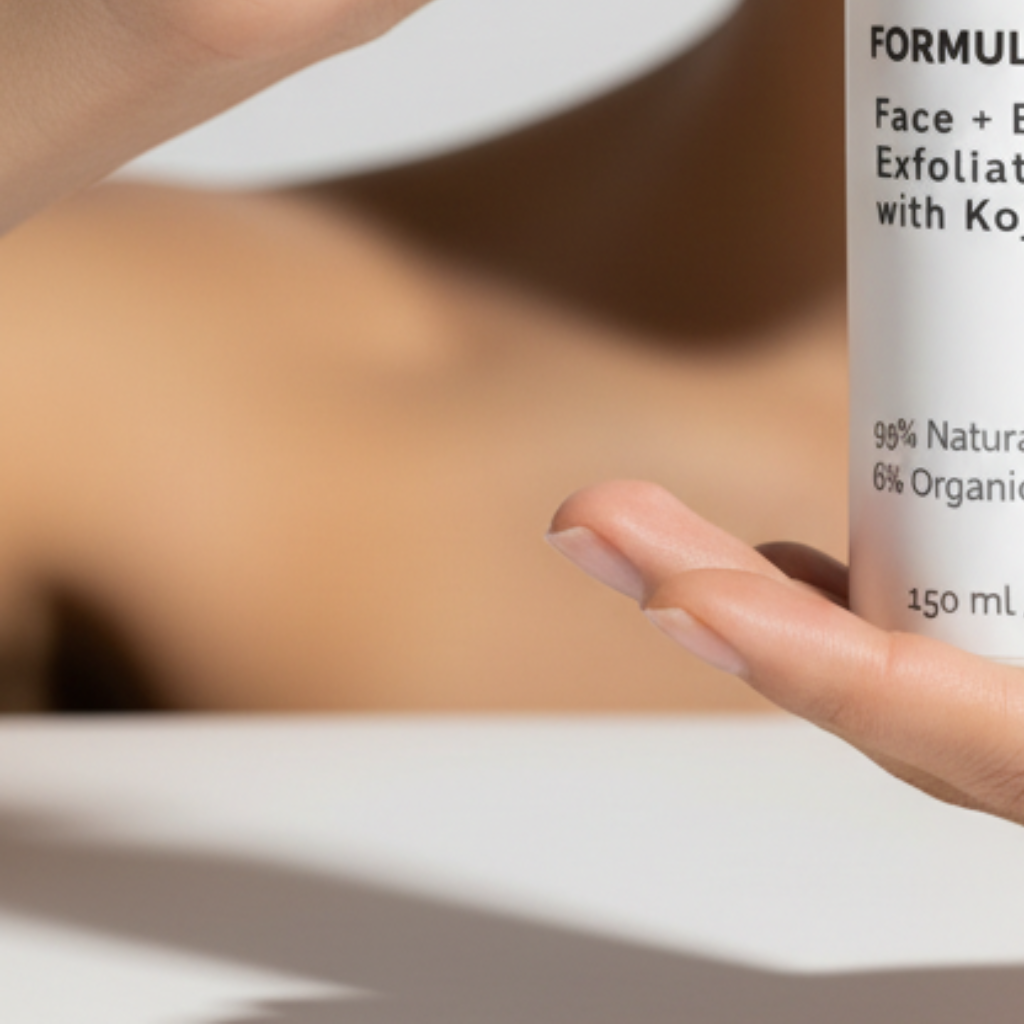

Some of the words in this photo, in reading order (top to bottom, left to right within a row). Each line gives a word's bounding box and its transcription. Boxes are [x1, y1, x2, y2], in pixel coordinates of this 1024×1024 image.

[875, 97, 954, 133] Face
[972, 110, 992, 129] +
[877, 193, 945, 229] with
[872, 462, 904, 494] 6%
[907, 587, 959, 619] 150
[970, 584, 1016, 616] ml
